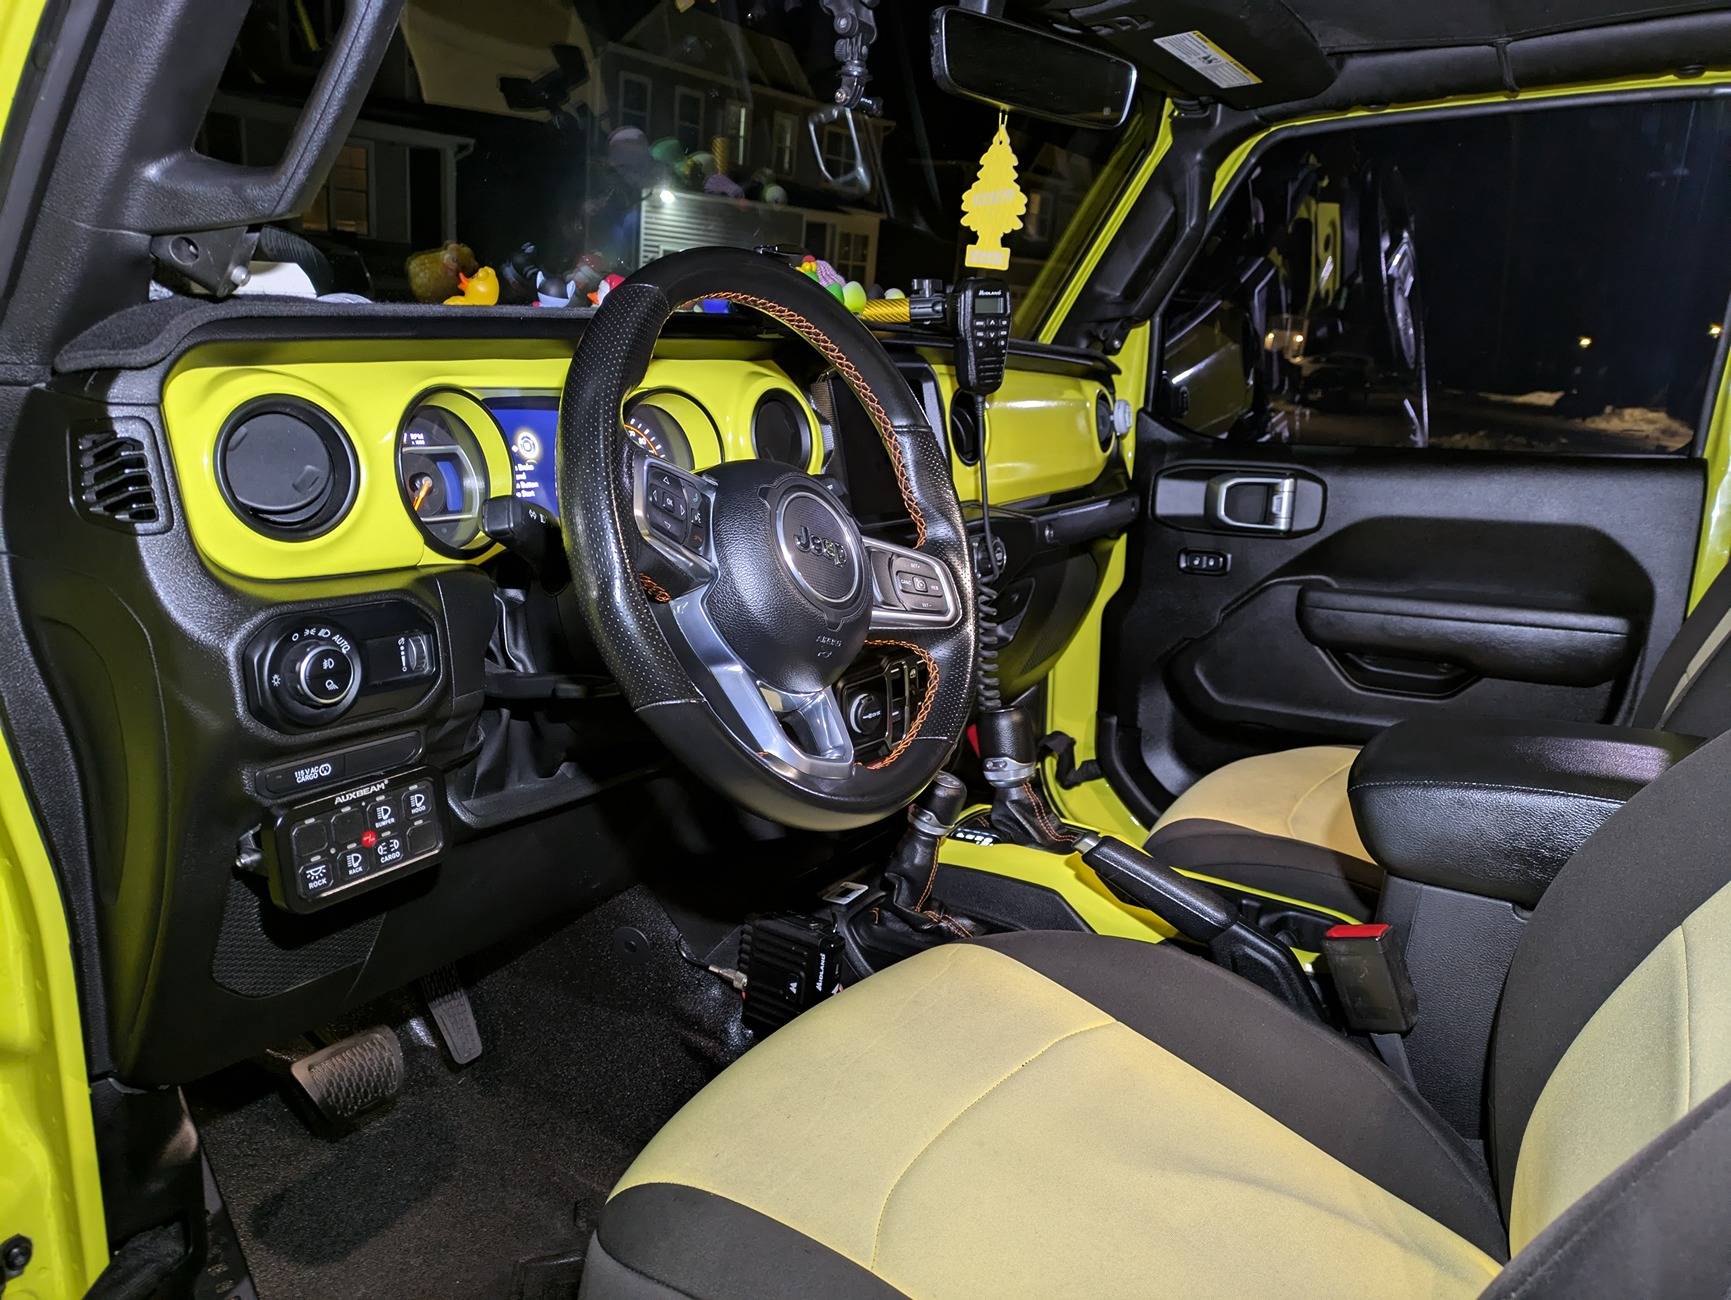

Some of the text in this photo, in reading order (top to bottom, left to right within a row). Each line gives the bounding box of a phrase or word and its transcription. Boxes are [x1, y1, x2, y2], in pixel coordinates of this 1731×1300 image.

[794, 526, 846, 568] Jeep
[332, 635, 350, 654] AUTO
[295, 769, 304, 778] 115
[296, 772, 318, 784] CARGO
[411, 805, 426, 814] HOOD
[375, 818, 395, 828] BUMPER
[381, 852, 400, 863] CARGO
[349, 866, 363, 876] RACK
[309, 878, 327, 890] ROCK
[816, 953, 826, 992] MIDLAND
